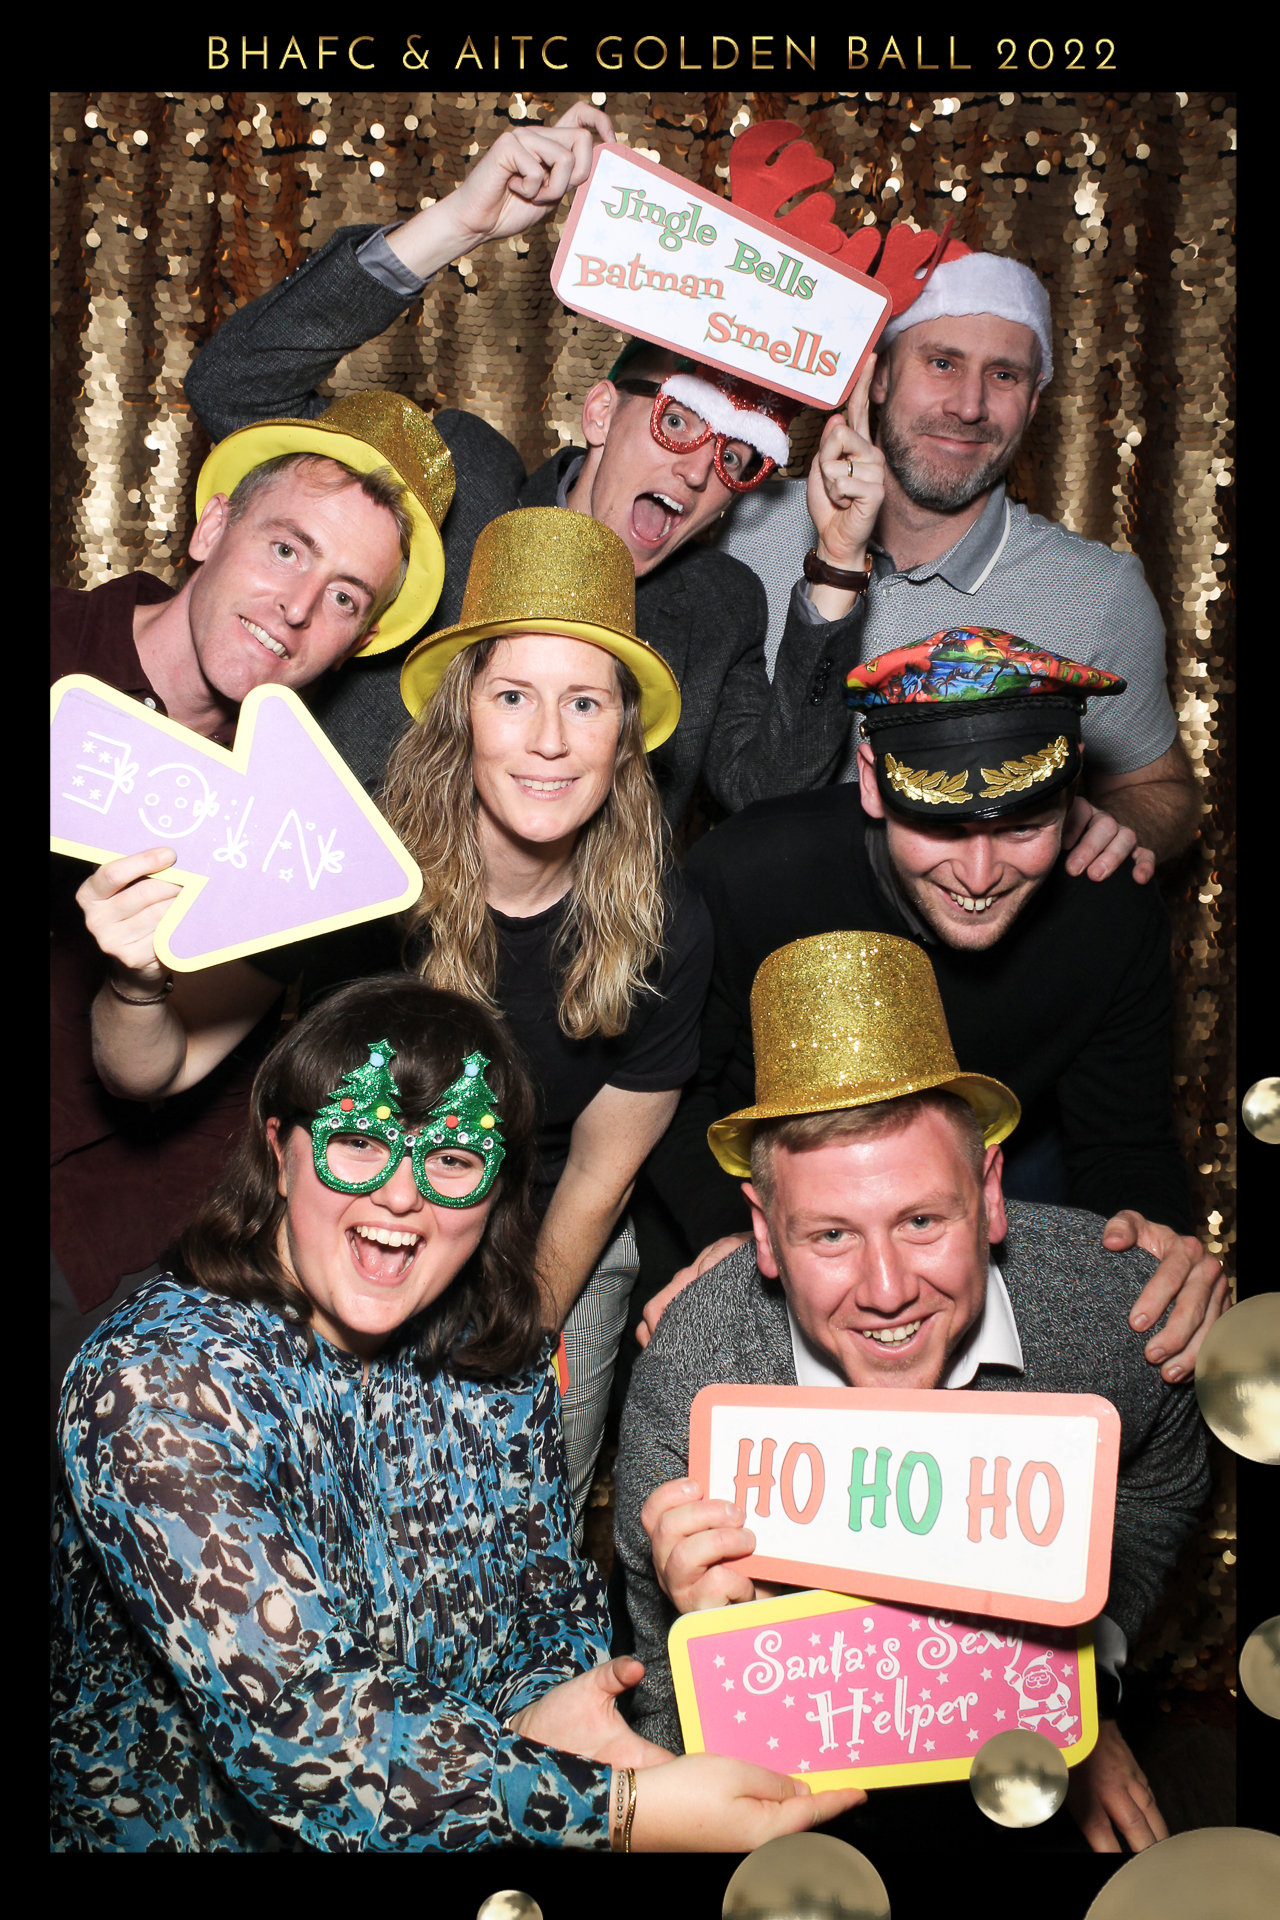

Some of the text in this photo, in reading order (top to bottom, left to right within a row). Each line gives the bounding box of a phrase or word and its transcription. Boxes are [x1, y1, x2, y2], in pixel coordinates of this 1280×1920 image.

[601, 186, 818, 300] Jingle Bells
[572, 253, 841, 376] Batman Smells
[733, 1437, 1065, 1547] HO HO HO
[742, 1608, 1025, 1695] Santa's Sexy
[805, 1675, 979, 1754] Helper
